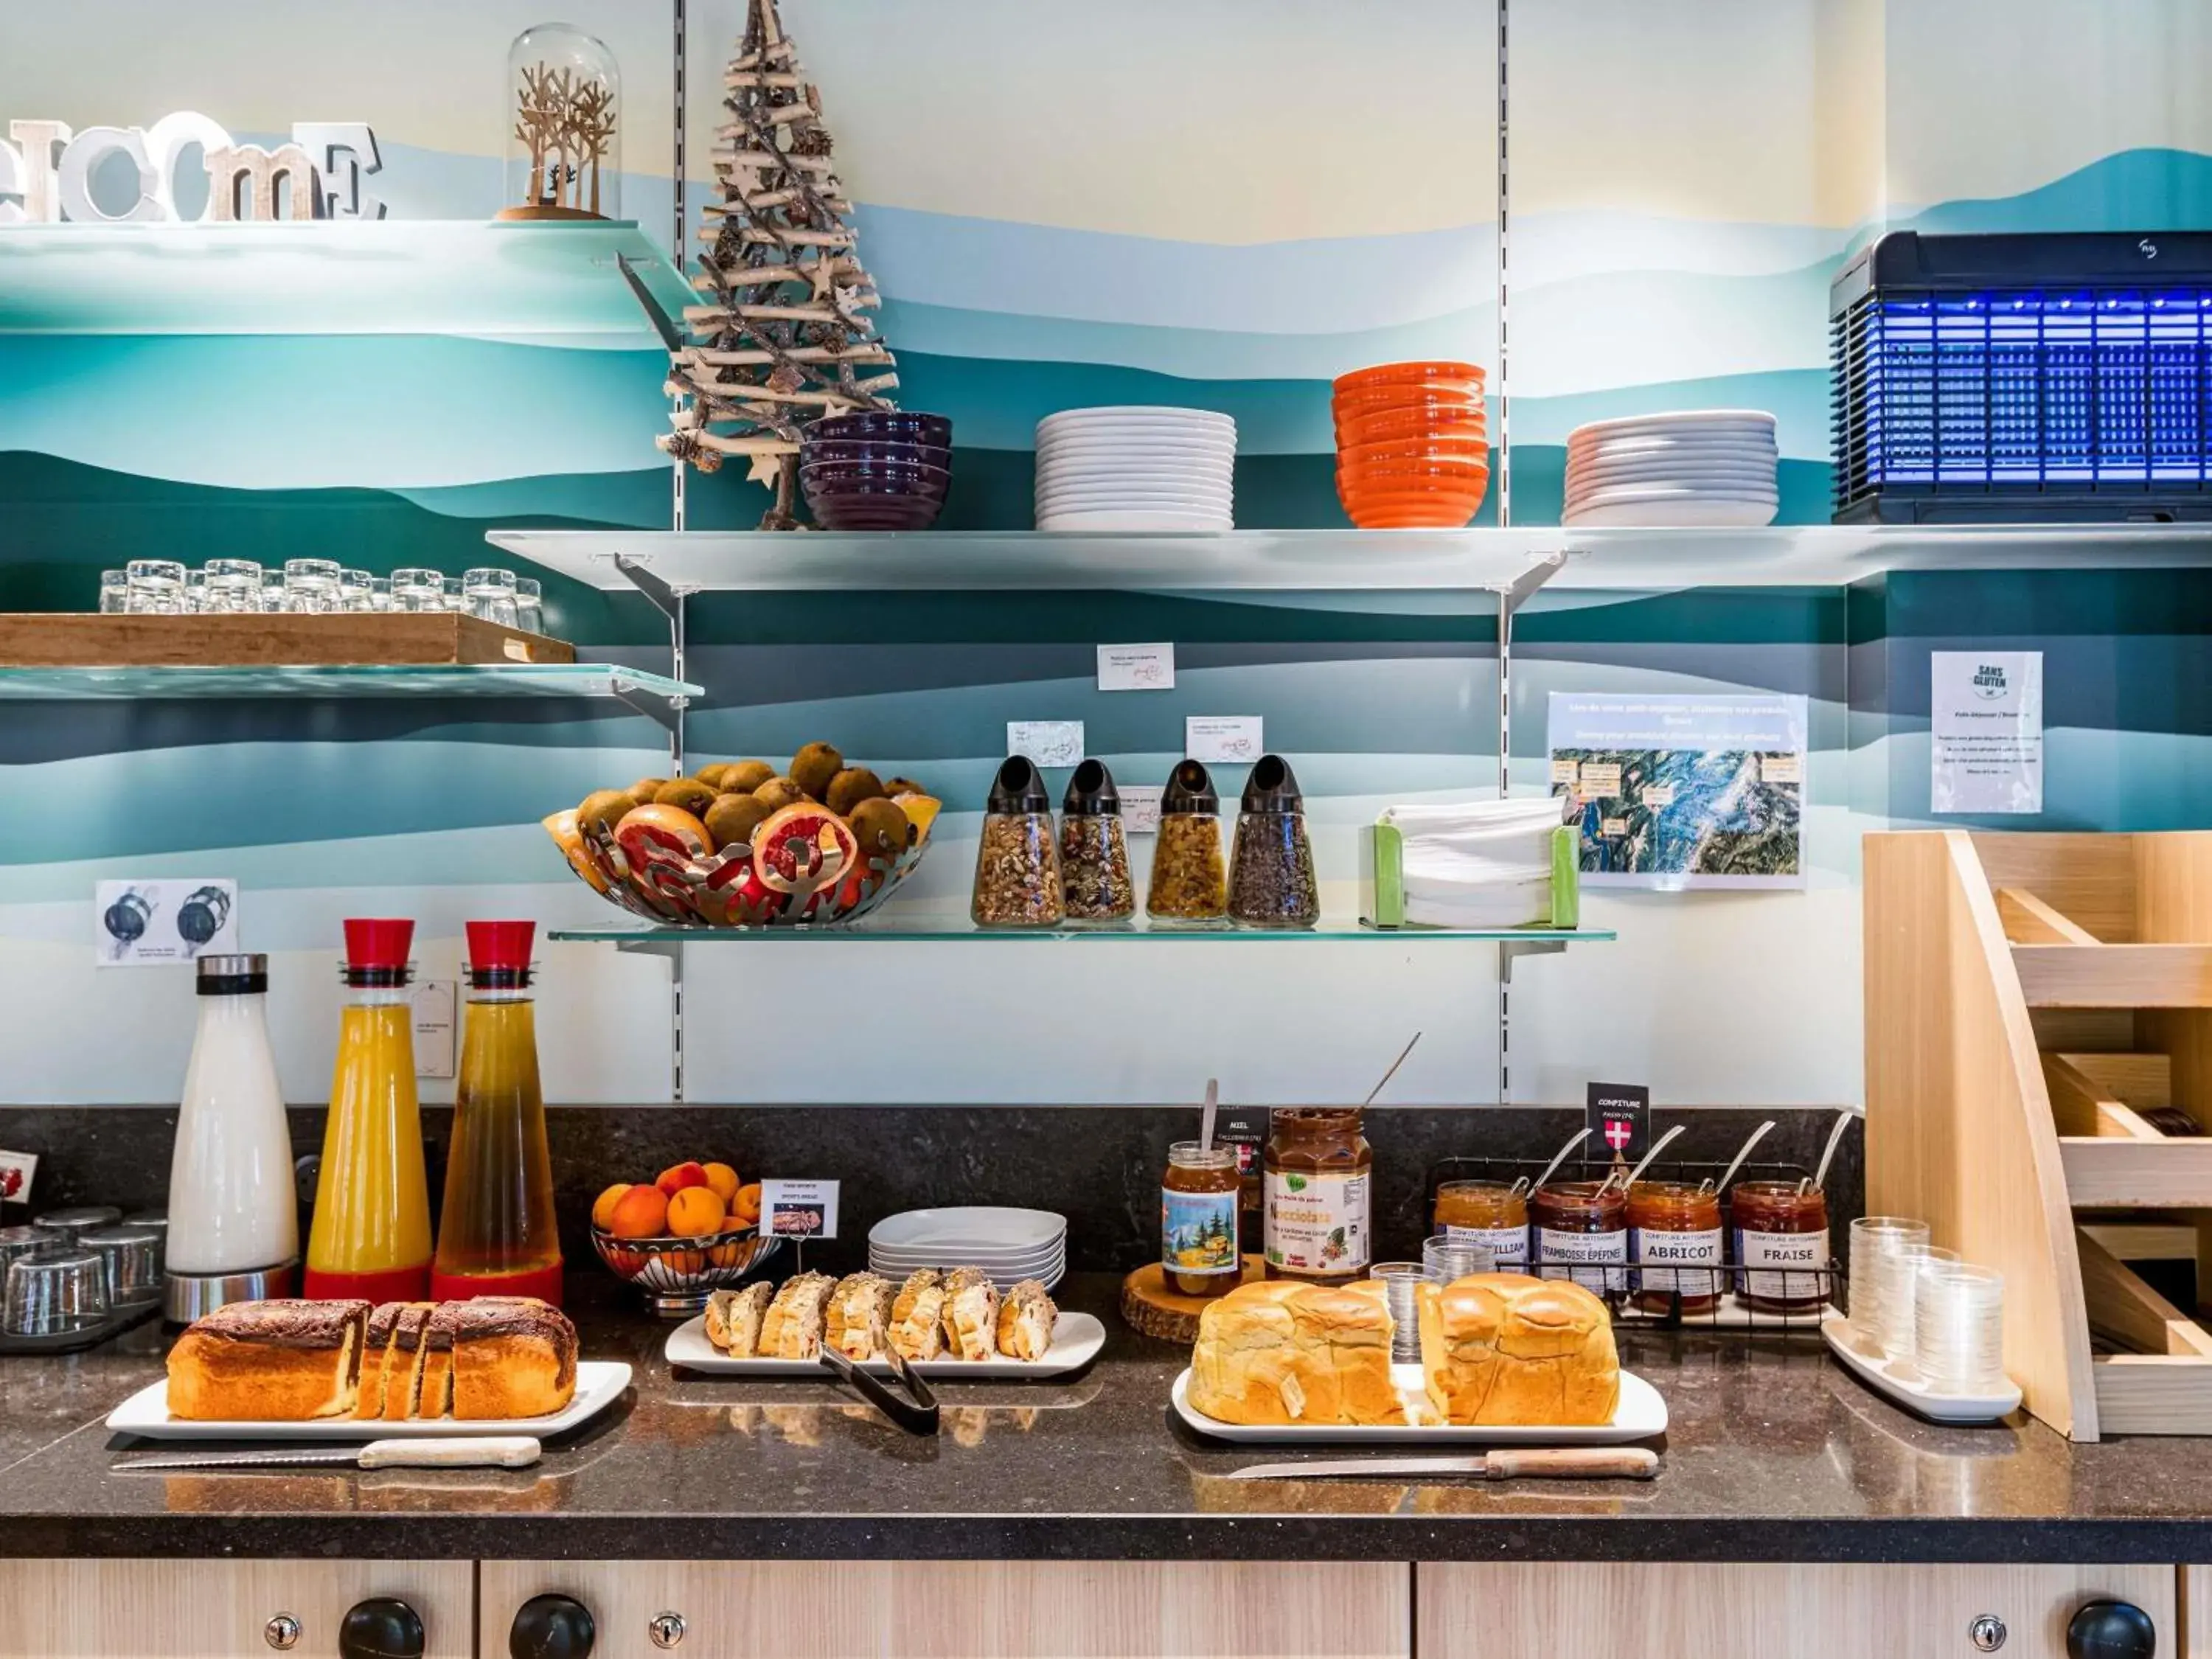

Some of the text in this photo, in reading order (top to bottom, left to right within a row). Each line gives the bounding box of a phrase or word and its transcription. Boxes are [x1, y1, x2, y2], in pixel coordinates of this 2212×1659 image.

[1978, 665, 2003, 677] SANS
[1974, 675, 2006, 688] GLUTEN
[1598, 1098, 1641, 1108] CONFITURE
[1229, 1121, 1248, 1129] MIEL
[1543, 1245, 1586, 1260] FRAMBOISE
[1648, 1245, 1714, 1259] ABRICOT
[1764, 1249, 1814, 1261] FRAISE
